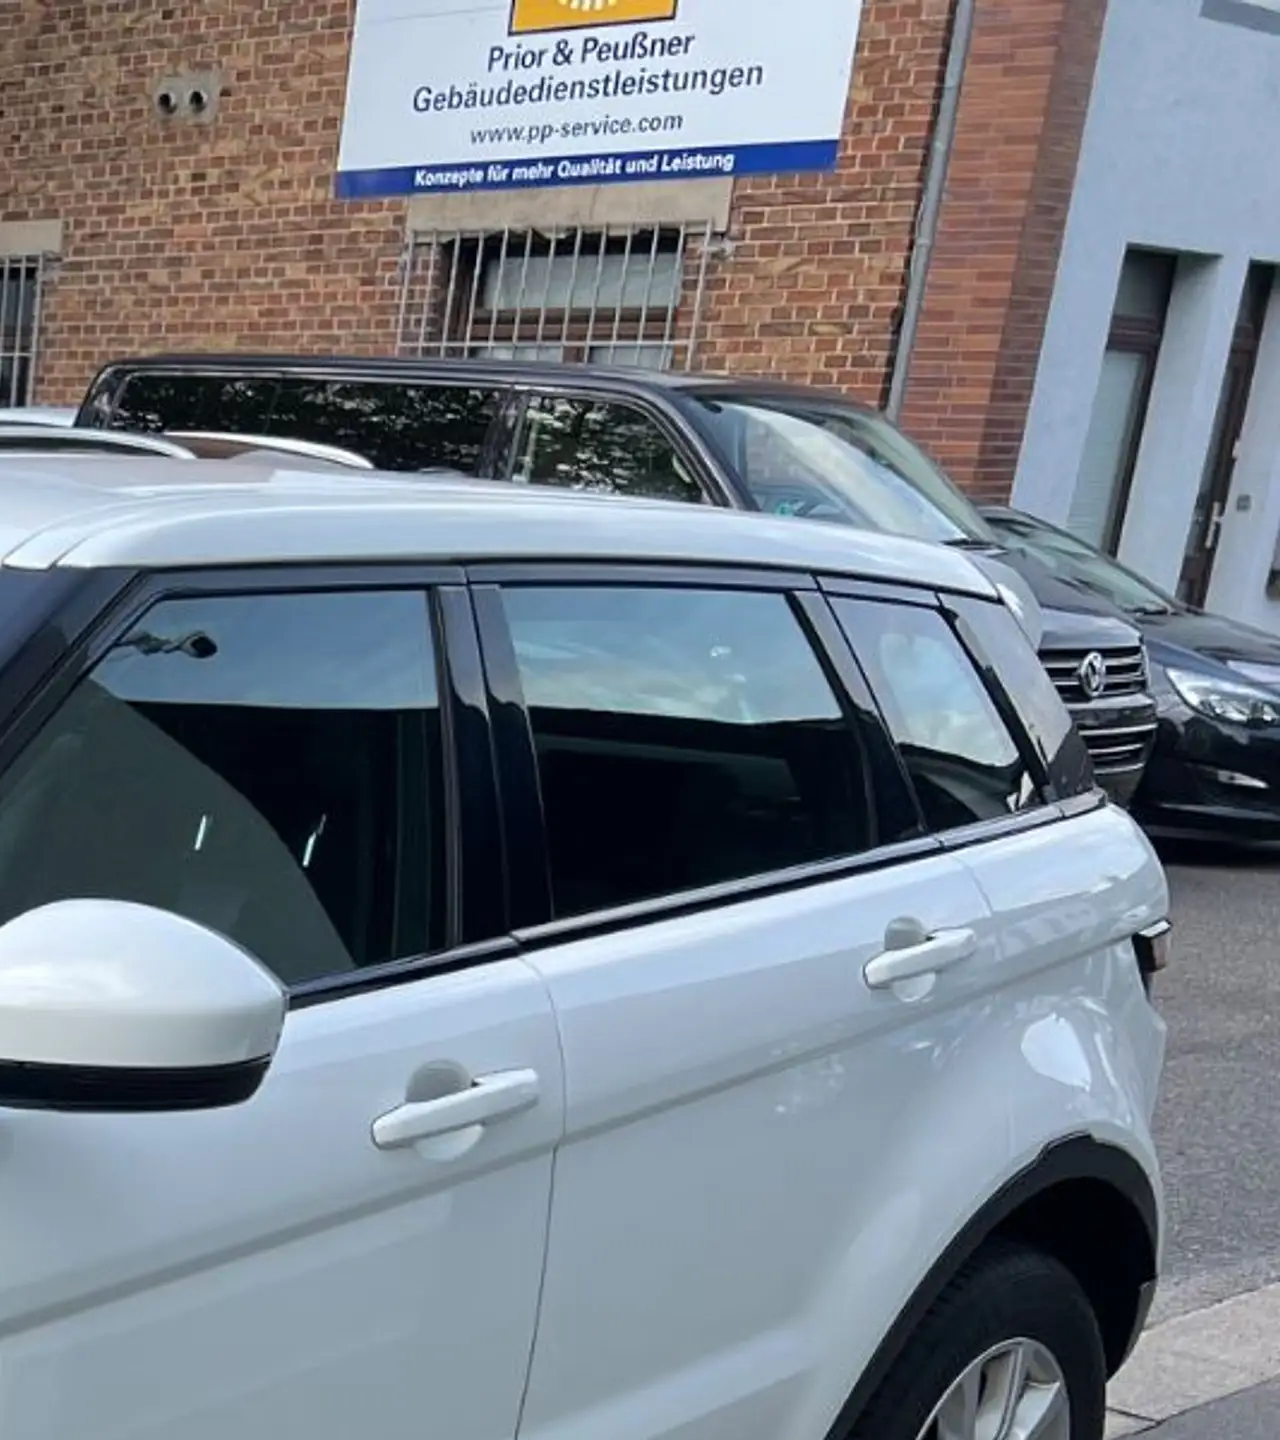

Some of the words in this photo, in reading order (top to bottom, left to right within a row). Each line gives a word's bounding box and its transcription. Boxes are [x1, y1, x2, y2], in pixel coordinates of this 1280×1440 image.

[487, 43, 549, 73] Prior
[552, 39, 574, 67] &
[580, 31, 696, 64] Peußner
[412, 64, 765, 113] Gebäudedienstleistungen
[469, 113, 684, 145] www.pp-service.com
[413, 166, 485, 189] Konzepte
[487, 163, 510, 182] für
[511, 161, 554, 180] mehr
[556, 157, 622, 179] Qualität
[624, 154, 658, 174] und
[660, 151, 736, 173] Leistung
